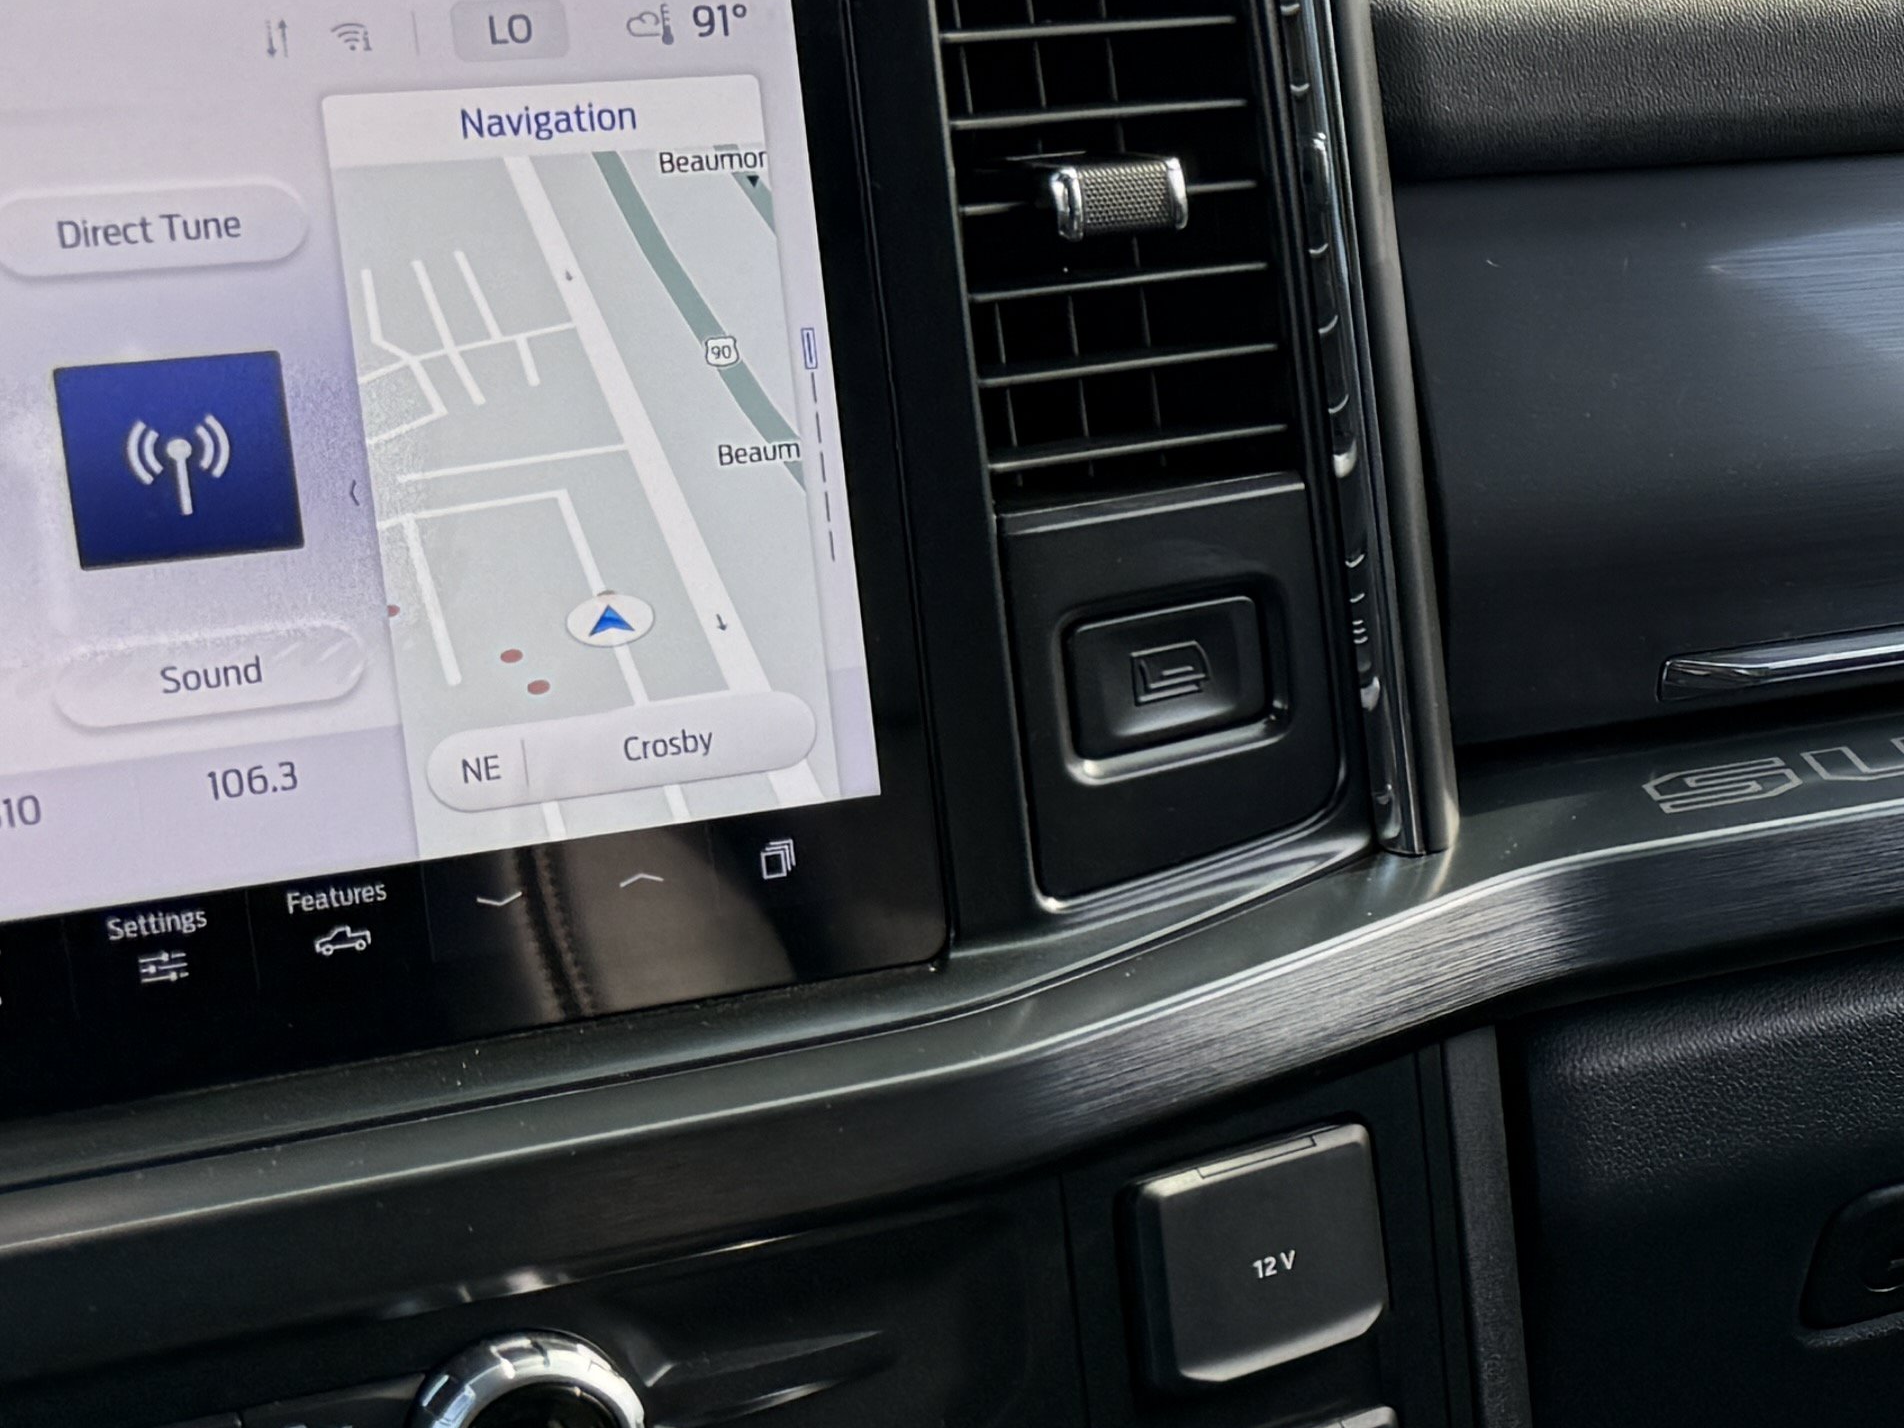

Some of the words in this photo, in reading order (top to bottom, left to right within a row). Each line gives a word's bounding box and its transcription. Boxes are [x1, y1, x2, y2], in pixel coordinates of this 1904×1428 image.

[488, 13, 533, 45] LO
[692, 3, 748, 37] 91°
[460, 102, 638, 141] Navigation
[56, 212, 150, 249] Direct
[157, 209, 243, 244] Tune
[710, 344, 732, 360] 90
[718, 442, 801, 466] Beaum
[160, 655, 264, 694] Sound
[621, 726, 714, 767] Crosby
[207, 760, 299, 802] 106.3
[459, 753, 503, 783] NE
[0, 794, 42, 830] 10
[286, 881, 388, 915] Features
[106, 906, 208, 942] Settings
[1252, 1255, 1278, 1279] 12
[1279, 1249, 1297, 1271] V
